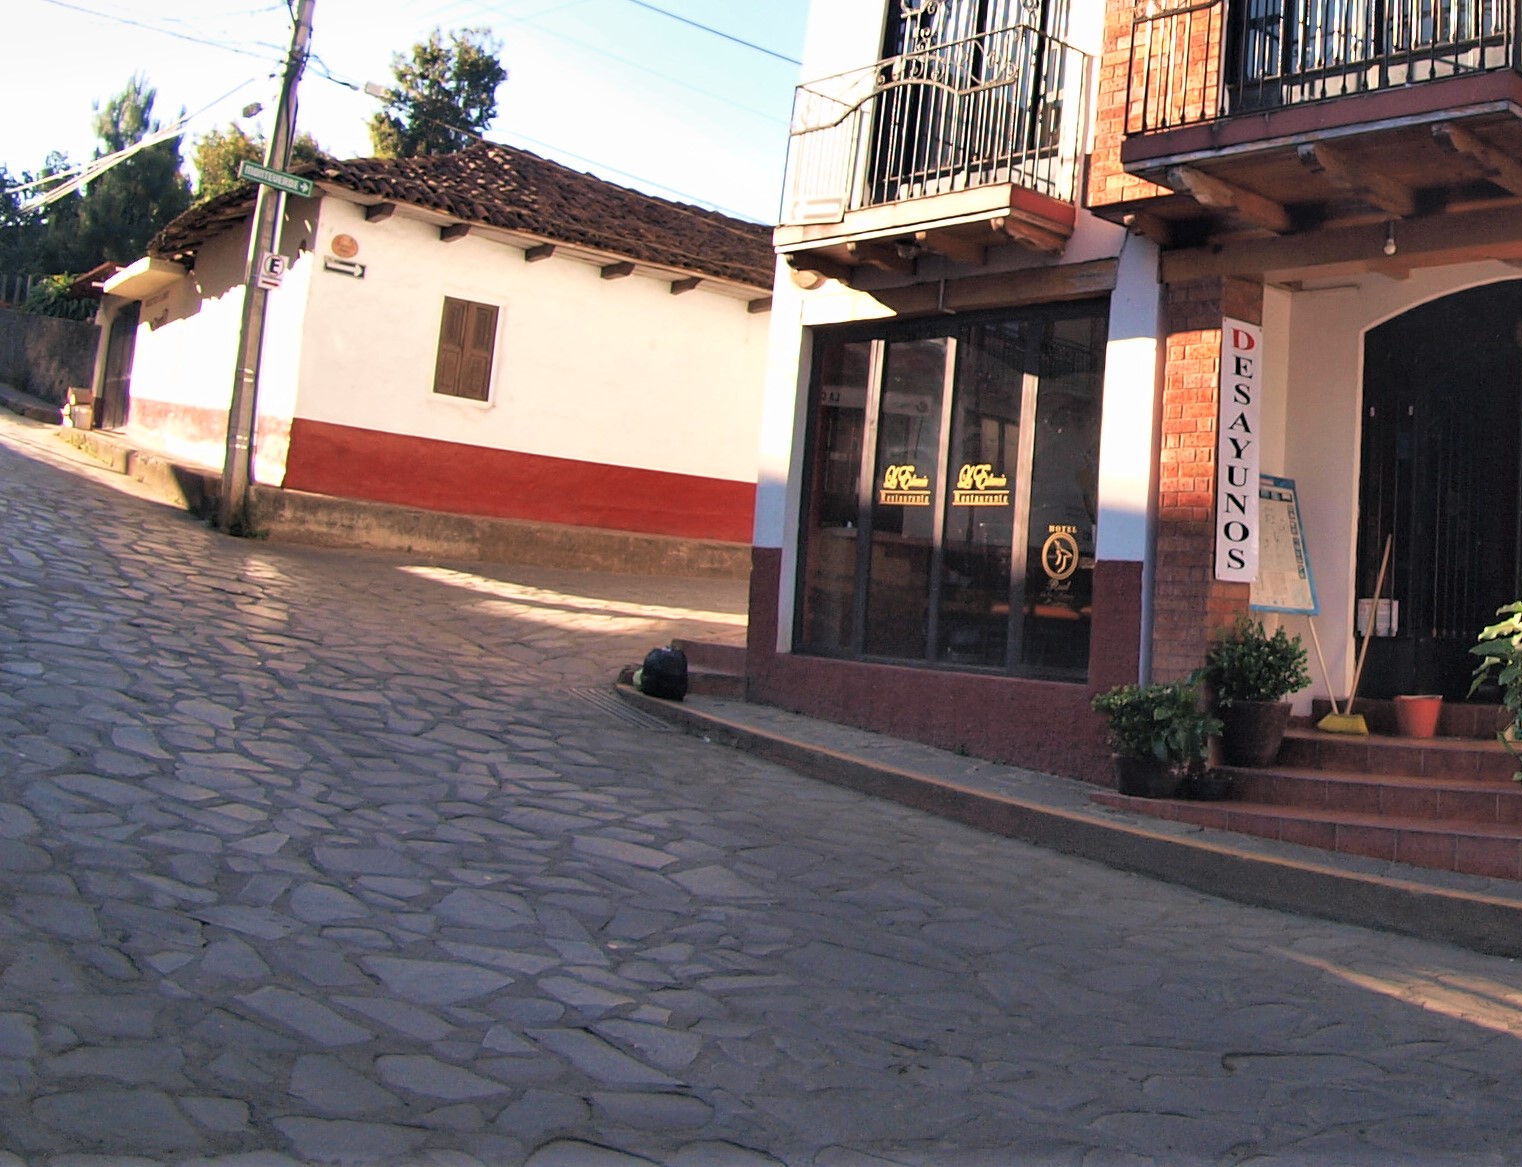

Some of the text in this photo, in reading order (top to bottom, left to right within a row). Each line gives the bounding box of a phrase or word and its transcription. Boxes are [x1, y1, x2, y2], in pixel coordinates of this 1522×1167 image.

[270, 258, 280, 274] E
[1223, 328, 1255, 570] DESAYUNOS
[1048, 524, 1077, 533] HOTEL
